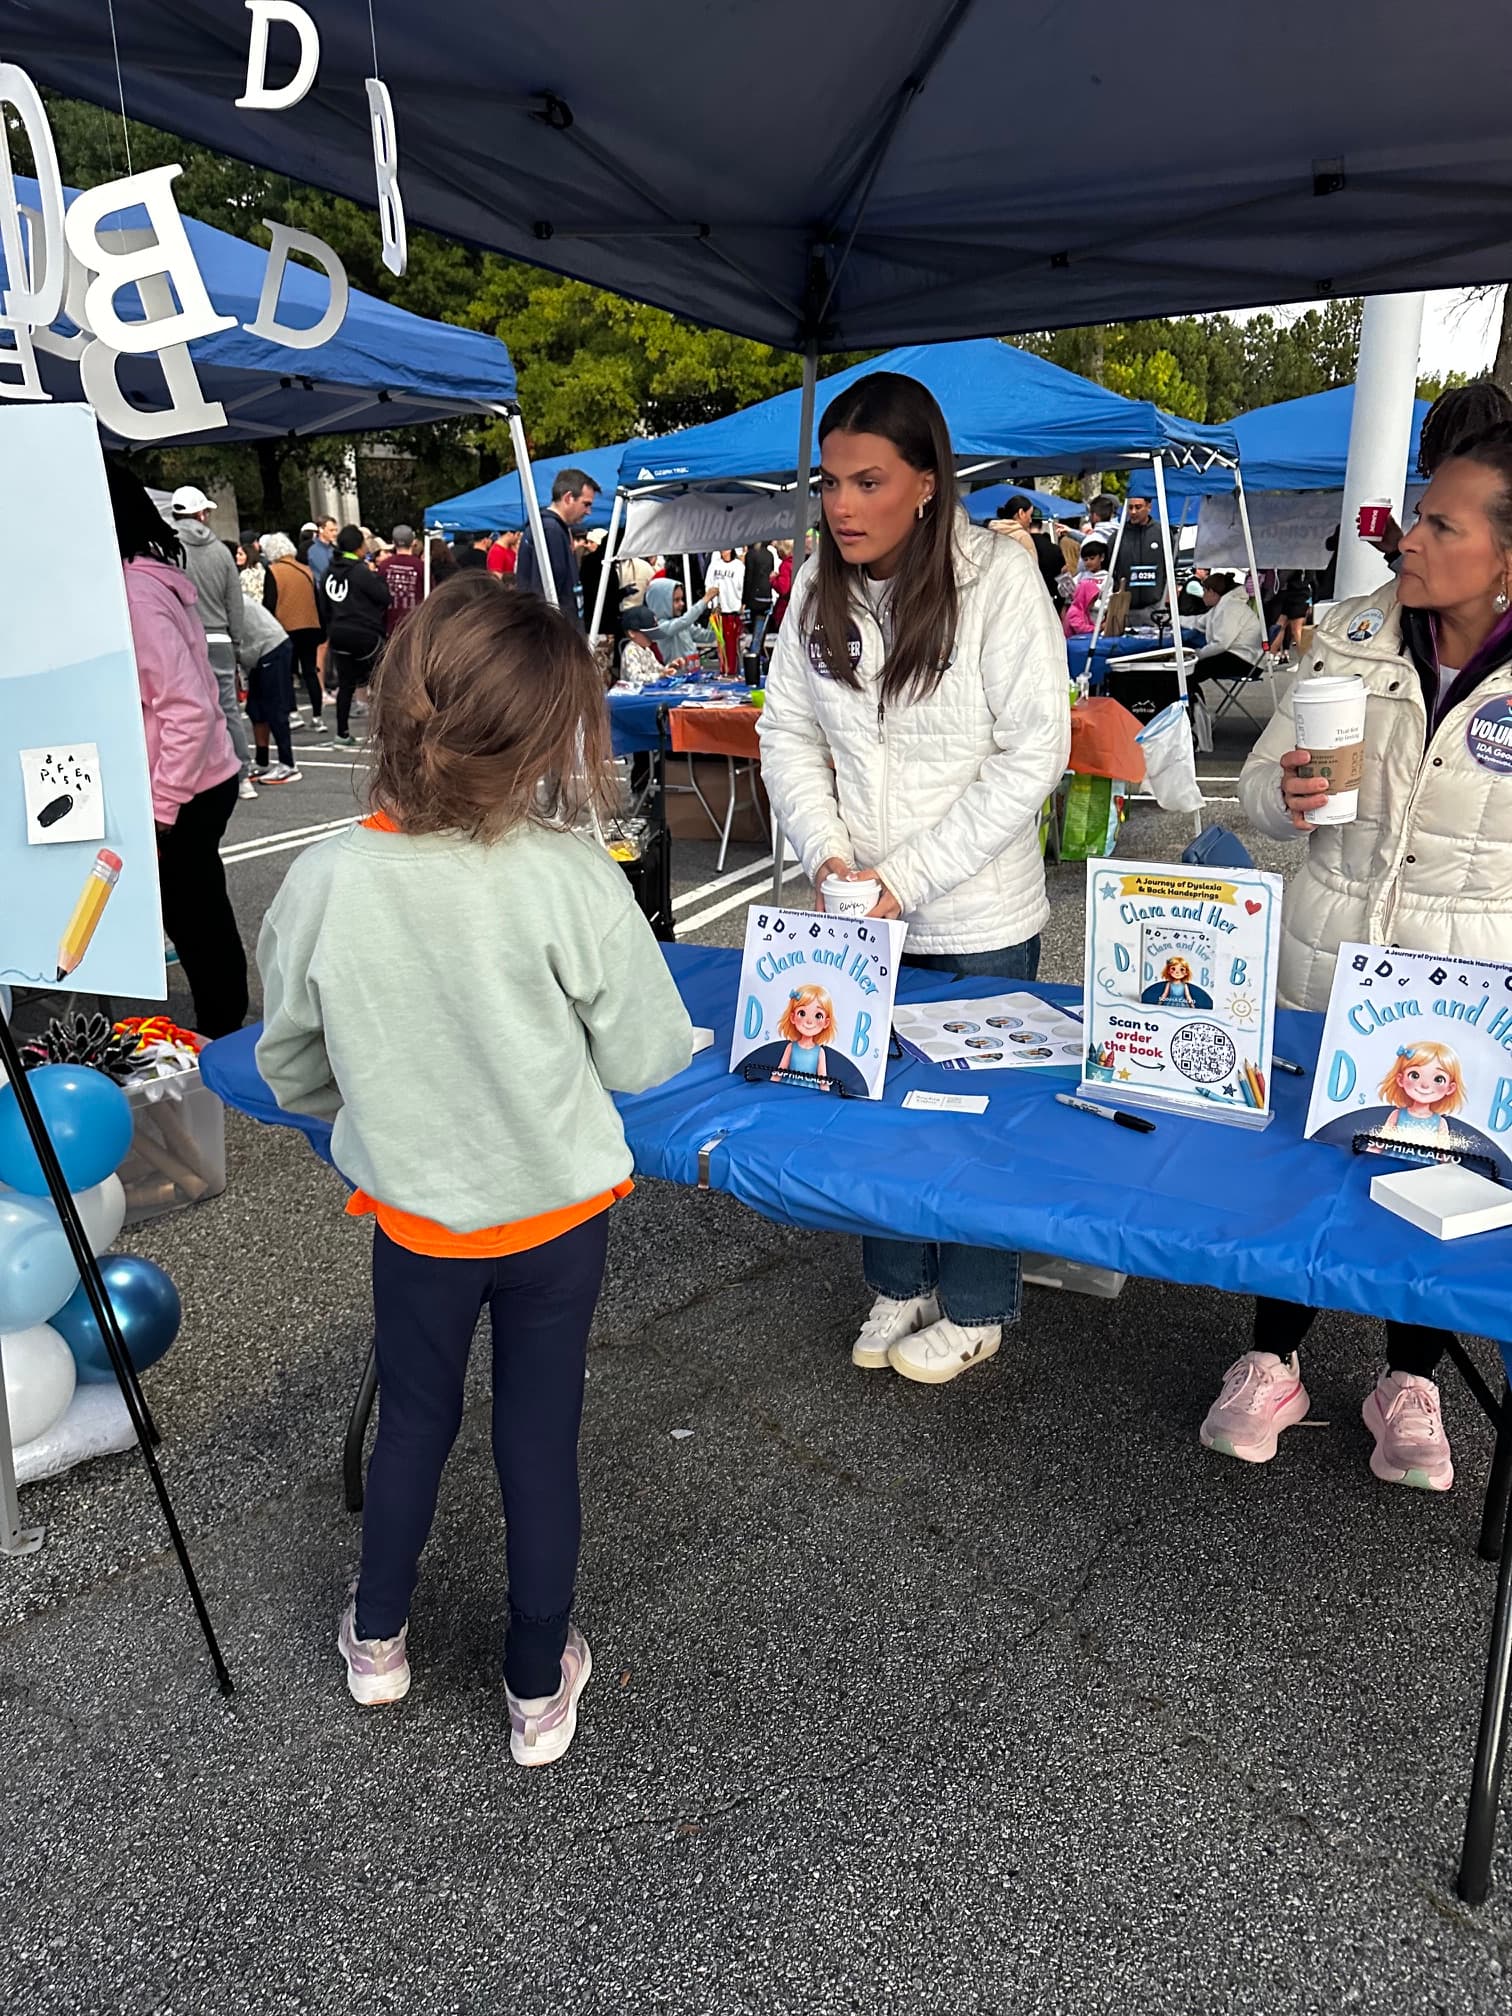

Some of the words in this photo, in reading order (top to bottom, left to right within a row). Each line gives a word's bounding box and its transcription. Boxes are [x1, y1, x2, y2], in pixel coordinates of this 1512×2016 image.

[235, 0, 320, 110] D
[242, 218, 349, 349] D
[1476, 743, 1492, 754] IDA
[1494, 748, 1512, 760] Geo
[1143, 878, 1175, 888] Journey
[1187, 881, 1222, 891] Dyslexia
[1147, 886, 1166, 895] Back
[1167, 888, 1219, 900] Handsprings
[1119, 901, 1166, 925] Clara
[1171, 901, 1204, 922] and
[1206, 905, 1238, 935] Her
[809, 922, 821, 938] B
[1147, 943, 1173, 957] Clara
[1176, 941, 1196, 951] and
[1390, 950, 1417, 959] Journey
[1425, 954, 1452, 963] Dyslexia
[1458, 958, 1474, 966] Back
[756, 951, 806, 982] Clara
[811, 943, 849, 970] and
[848, 952, 879, 996] Her
[1375, 960, 1393, 978] D
[1428, 967, 1448, 986] B
[1109, 1016, 1141, 1029] Scan
[1144, 1022, 1159, 1031] to
[1347, 998, 1423, 1036] Clara
[1432, 994, 1489, 1027] and
[1116, 1031, 1152, 1043] order
[1104, 1040, 1126, 1052] the
[1130, 1043, 1163, 1058] book
